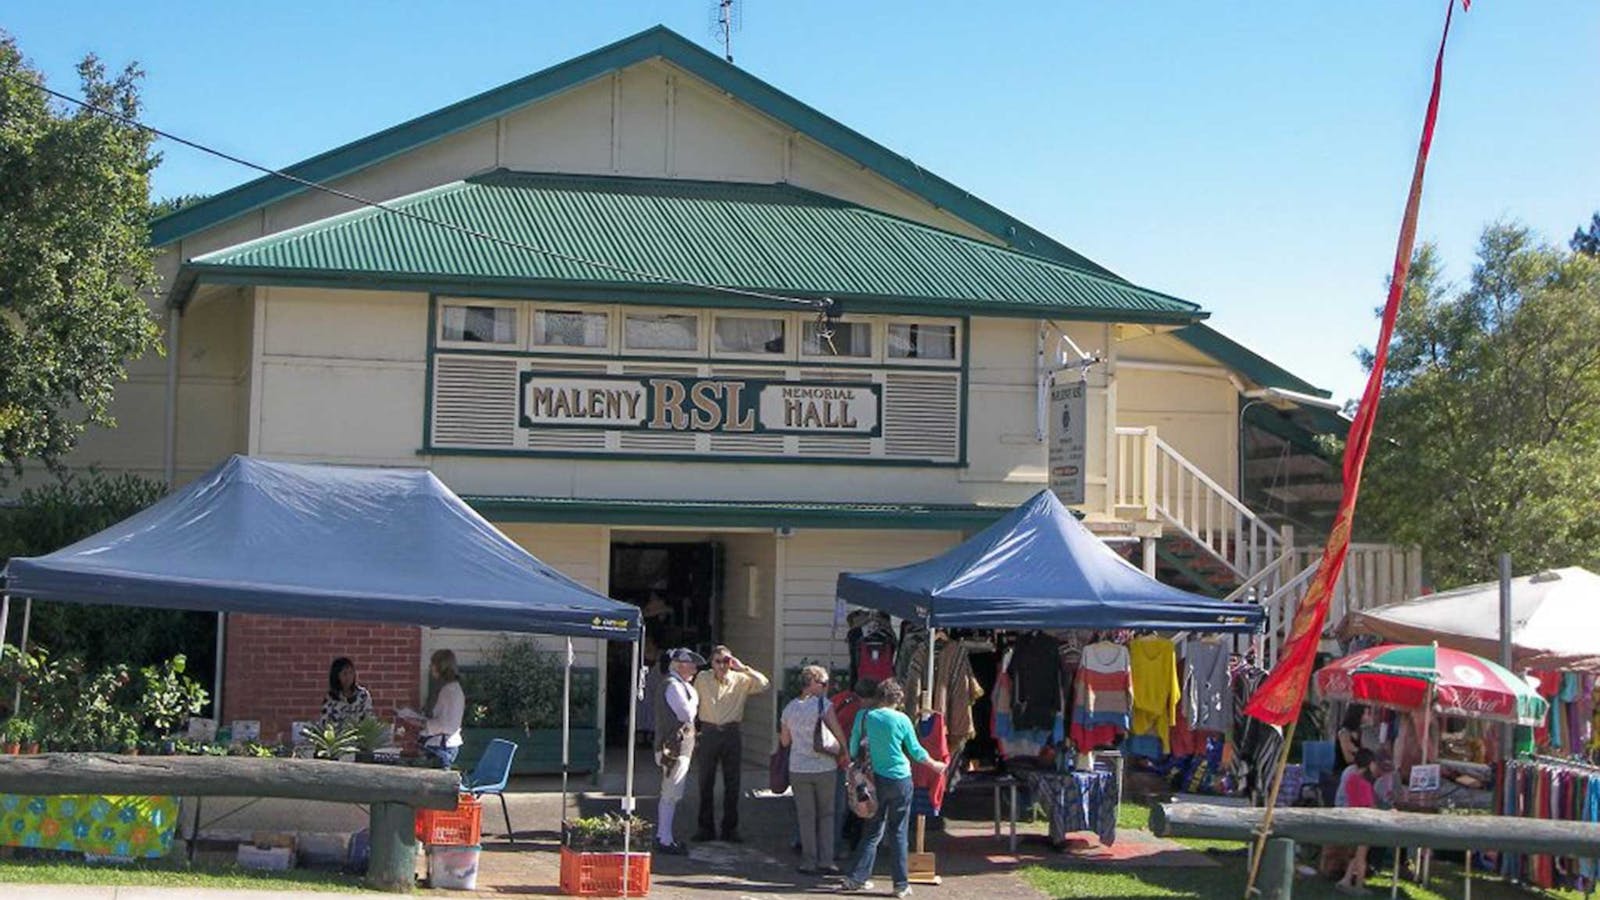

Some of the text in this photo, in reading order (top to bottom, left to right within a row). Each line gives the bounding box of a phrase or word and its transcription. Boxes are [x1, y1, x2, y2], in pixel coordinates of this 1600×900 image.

[532, 379, 756, 431] MALENY RSL
[782, 387, 856, 400] MEMORIAL
[784, 399, 858, 429] HALL
